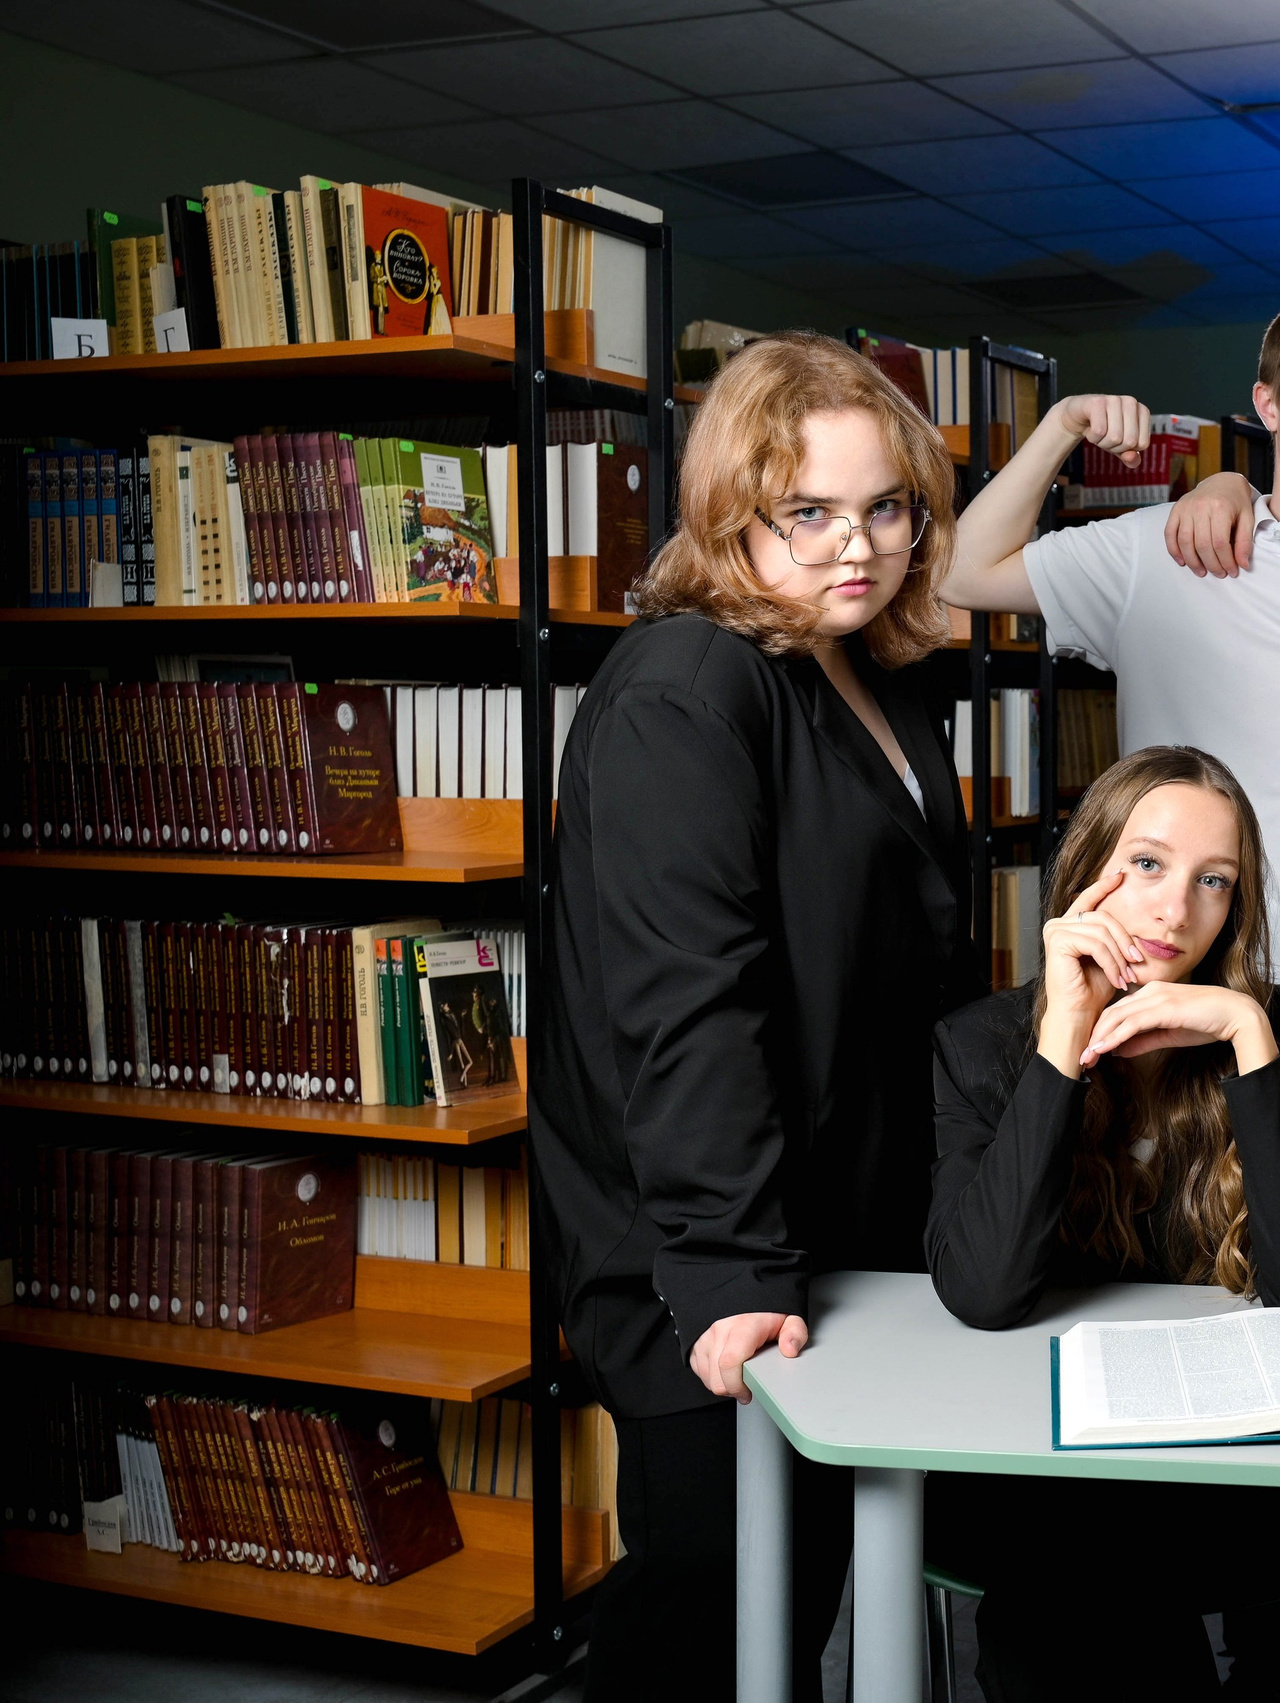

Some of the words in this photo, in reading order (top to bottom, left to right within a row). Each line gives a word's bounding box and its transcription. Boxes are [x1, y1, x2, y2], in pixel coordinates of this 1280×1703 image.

[74, 334, 95, 358] Б
[162, 327, 175, 353] Г
[329, 746, 339, 757] Н.
[340, 746, 348, 757] В.
[349, 747, 372, 758] Гоголь
[325, 765, 349, 776] Вечера
[358, 769, 380, 778] хуторе
[329, 777, 345, 785] близ
[346, 776, 379, 786] Диканьки
[338, 788, 373, 799] Миргород
[358, 967, 366, 1000] ГОГОЛЬ
[302, 1212, 337, 1227] Гончаров
[289, 1234, 325, 1248] Обломов
[385, 1484, 402, 1497] Горе
